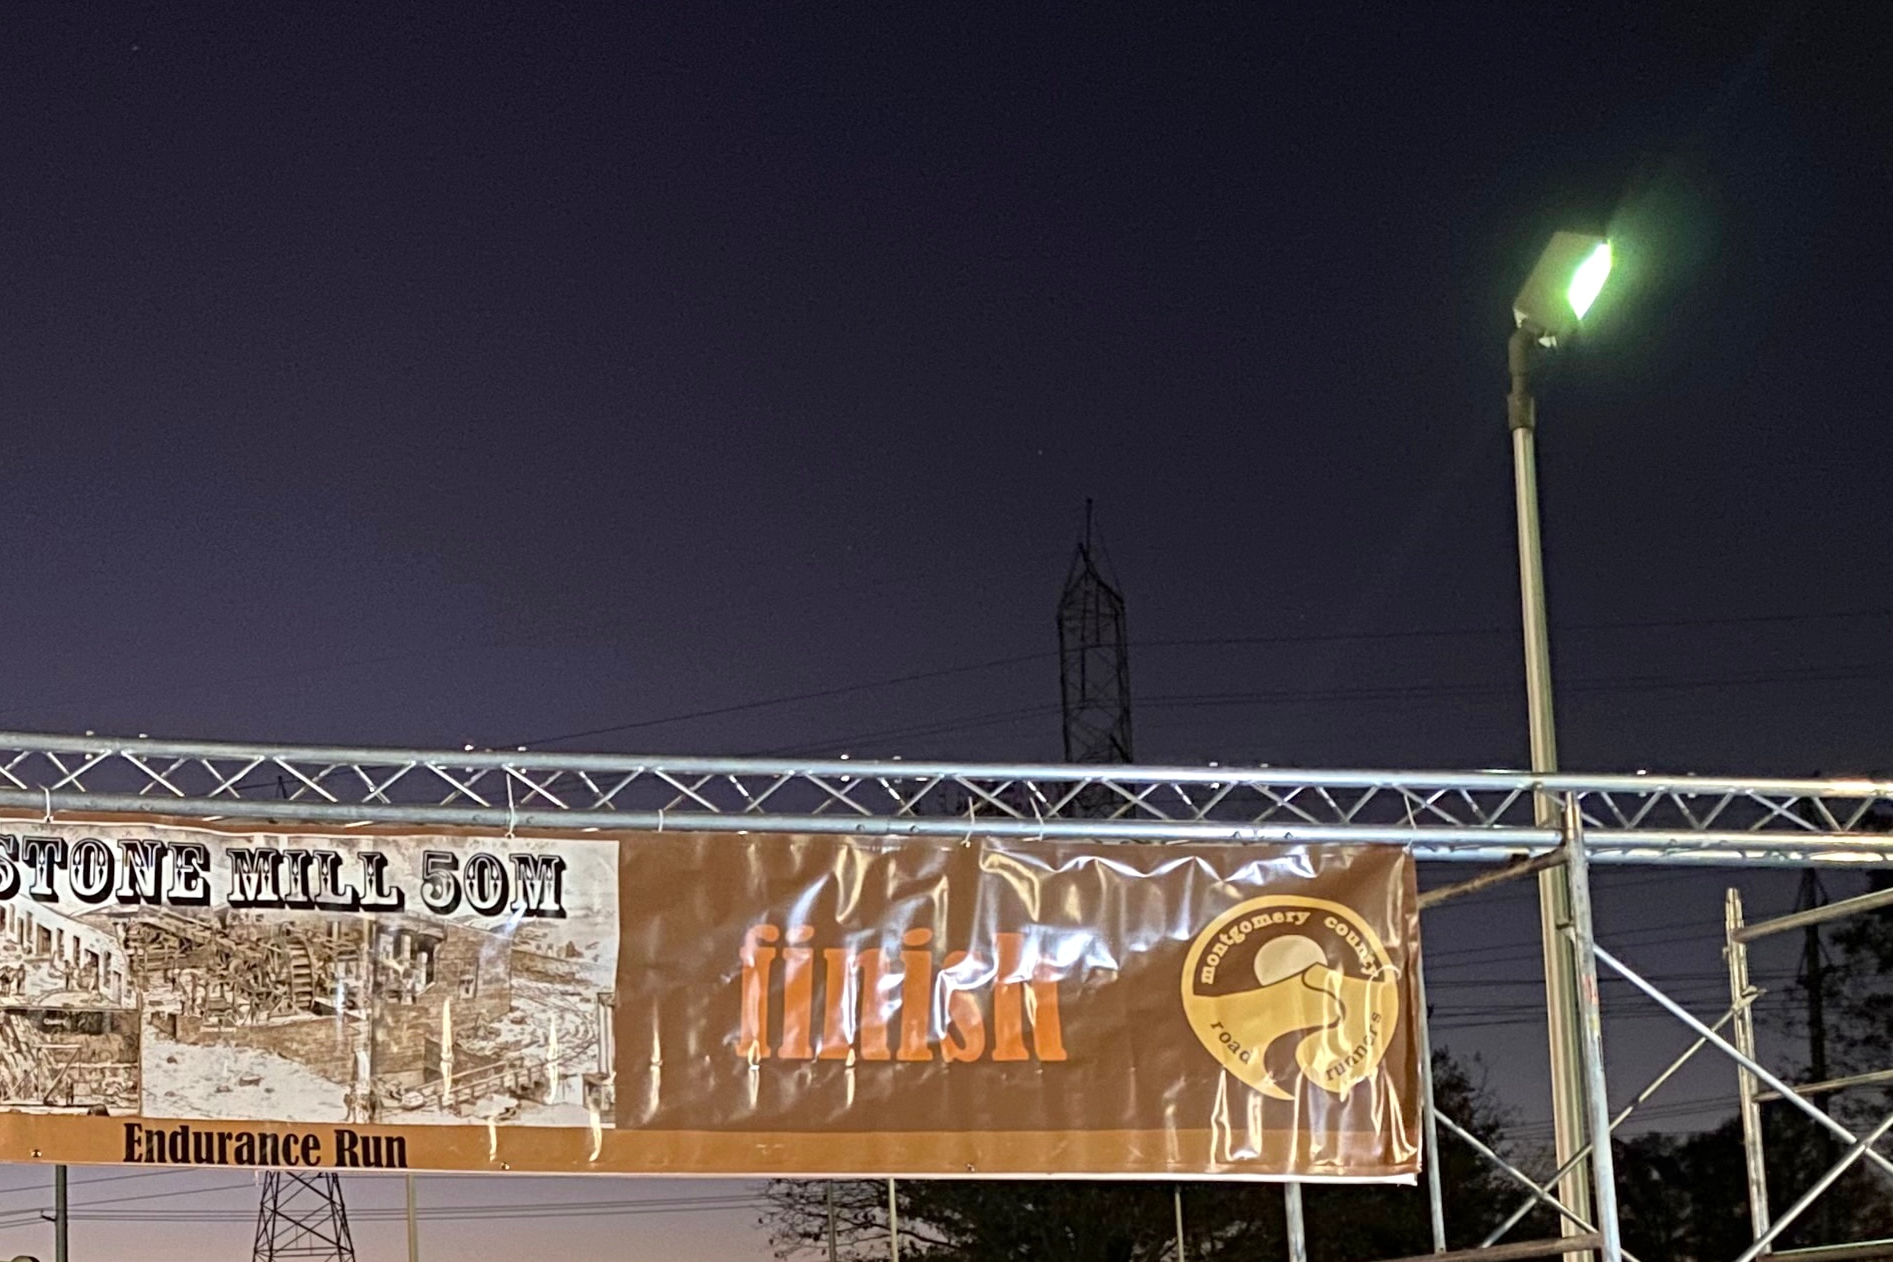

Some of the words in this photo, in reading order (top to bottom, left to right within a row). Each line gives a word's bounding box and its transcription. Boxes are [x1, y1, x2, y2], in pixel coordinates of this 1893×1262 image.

[225, 846, 406, 913] MILL
[419, 850, 567, 919] 50M
[1200, 911, 1311, 985] montgomery
[1323, 915, 1381, 978] county
[735, 924, 1068, 1063] finish
[1210, 1020, 1254, 1065] road
[1325, 1011, 1382, 1082] runners
[122, 1122, 322, 1167] Endurance
[333, 1128, 409, 1169] Run
